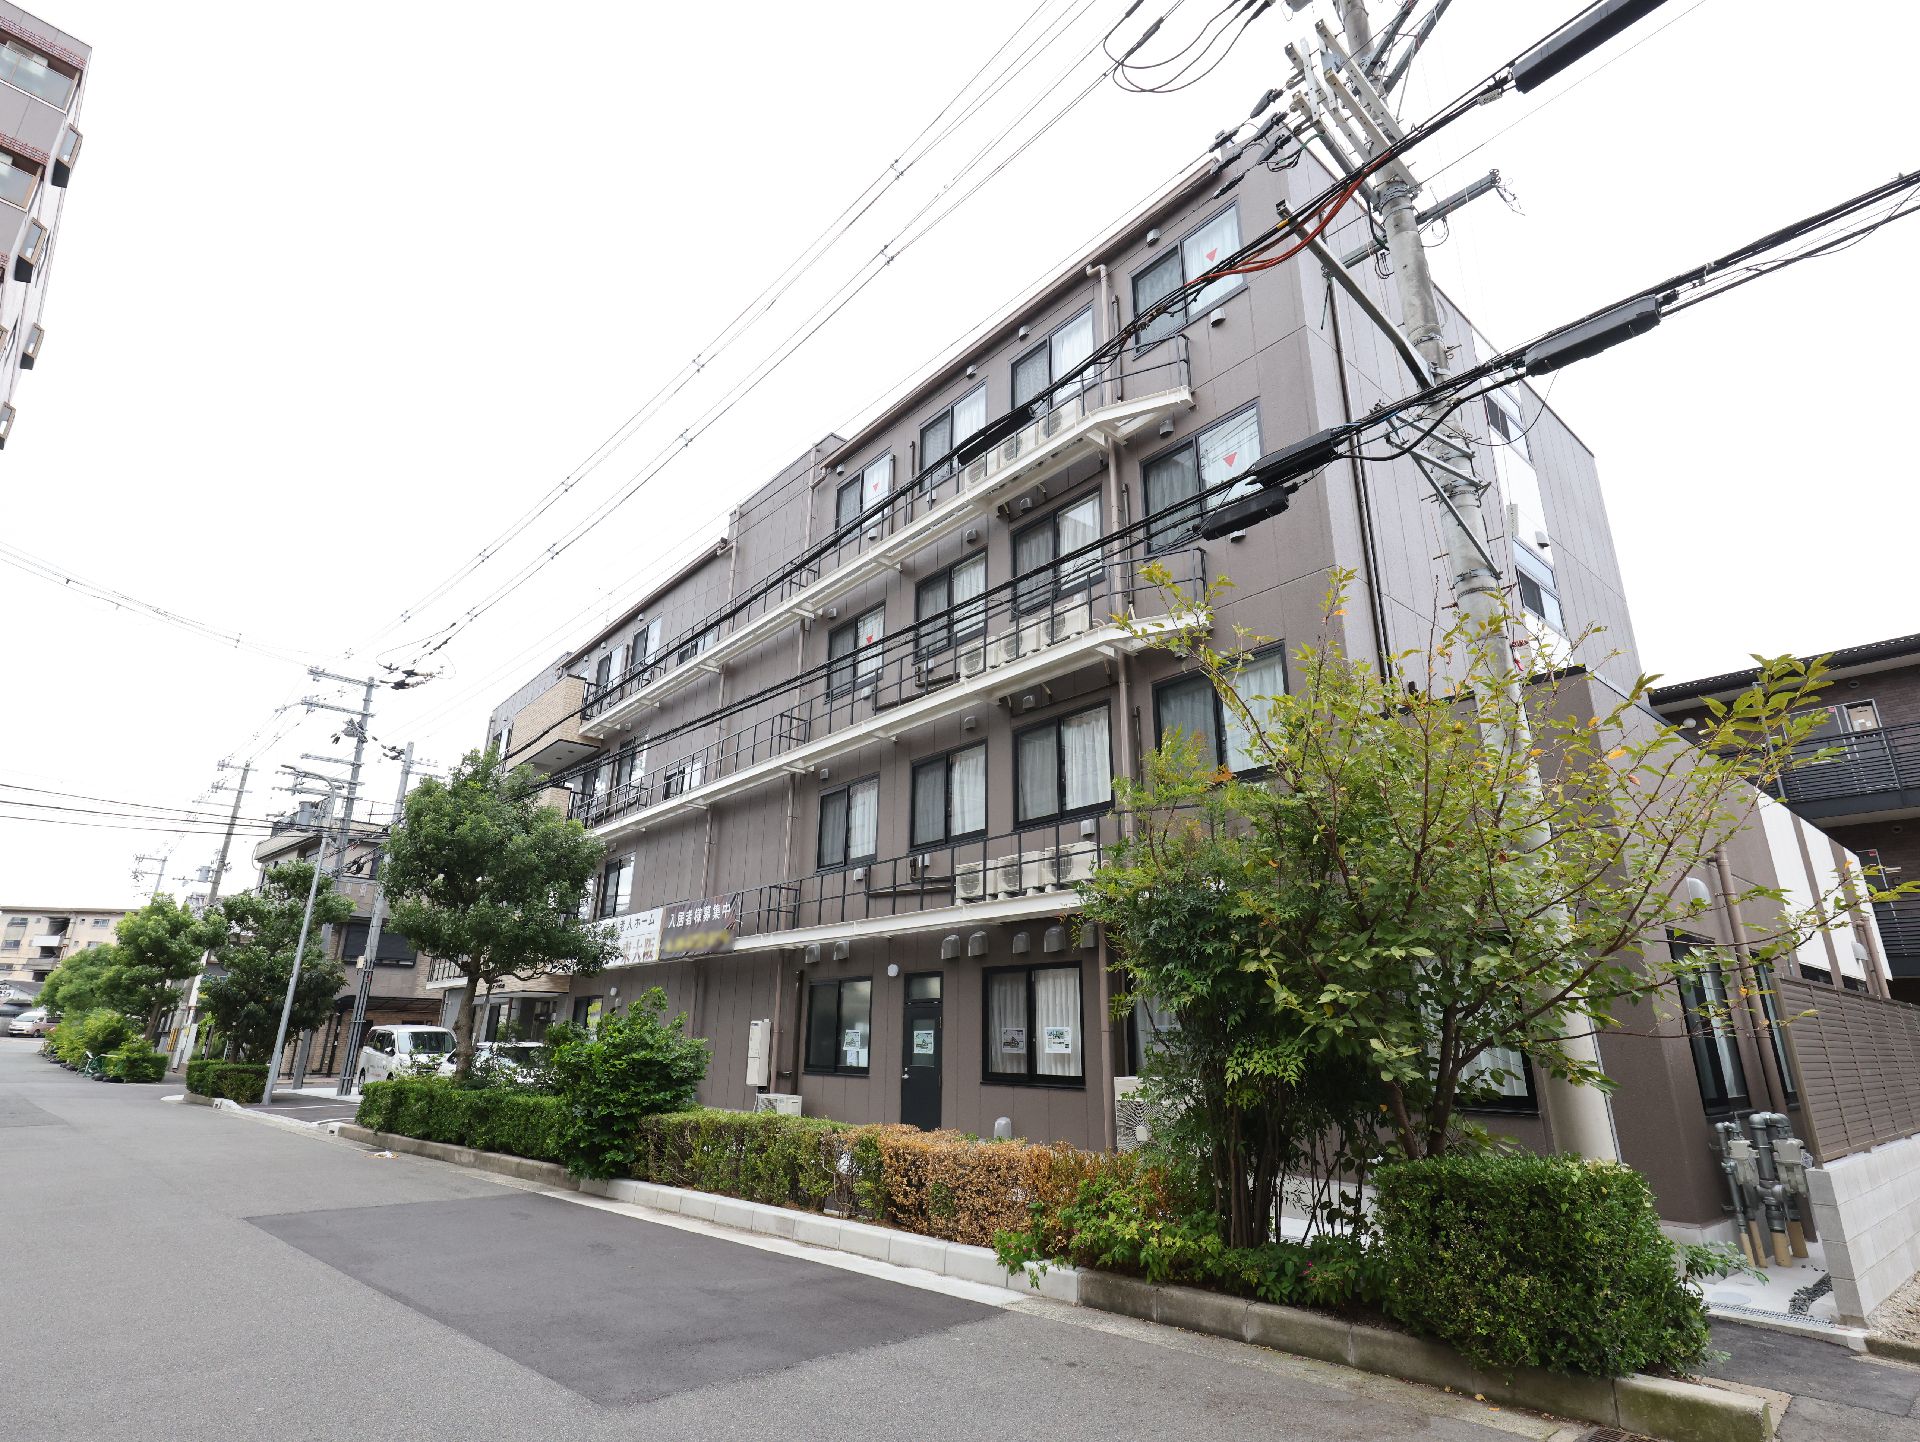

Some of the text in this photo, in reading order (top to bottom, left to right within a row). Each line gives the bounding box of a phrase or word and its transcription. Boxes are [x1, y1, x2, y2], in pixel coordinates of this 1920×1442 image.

[615, 914, 655, 932] 老人ホーム
[668, 902, 731, 928] 入居者様募集中
[615, 937, 656, 965] 東大阪
